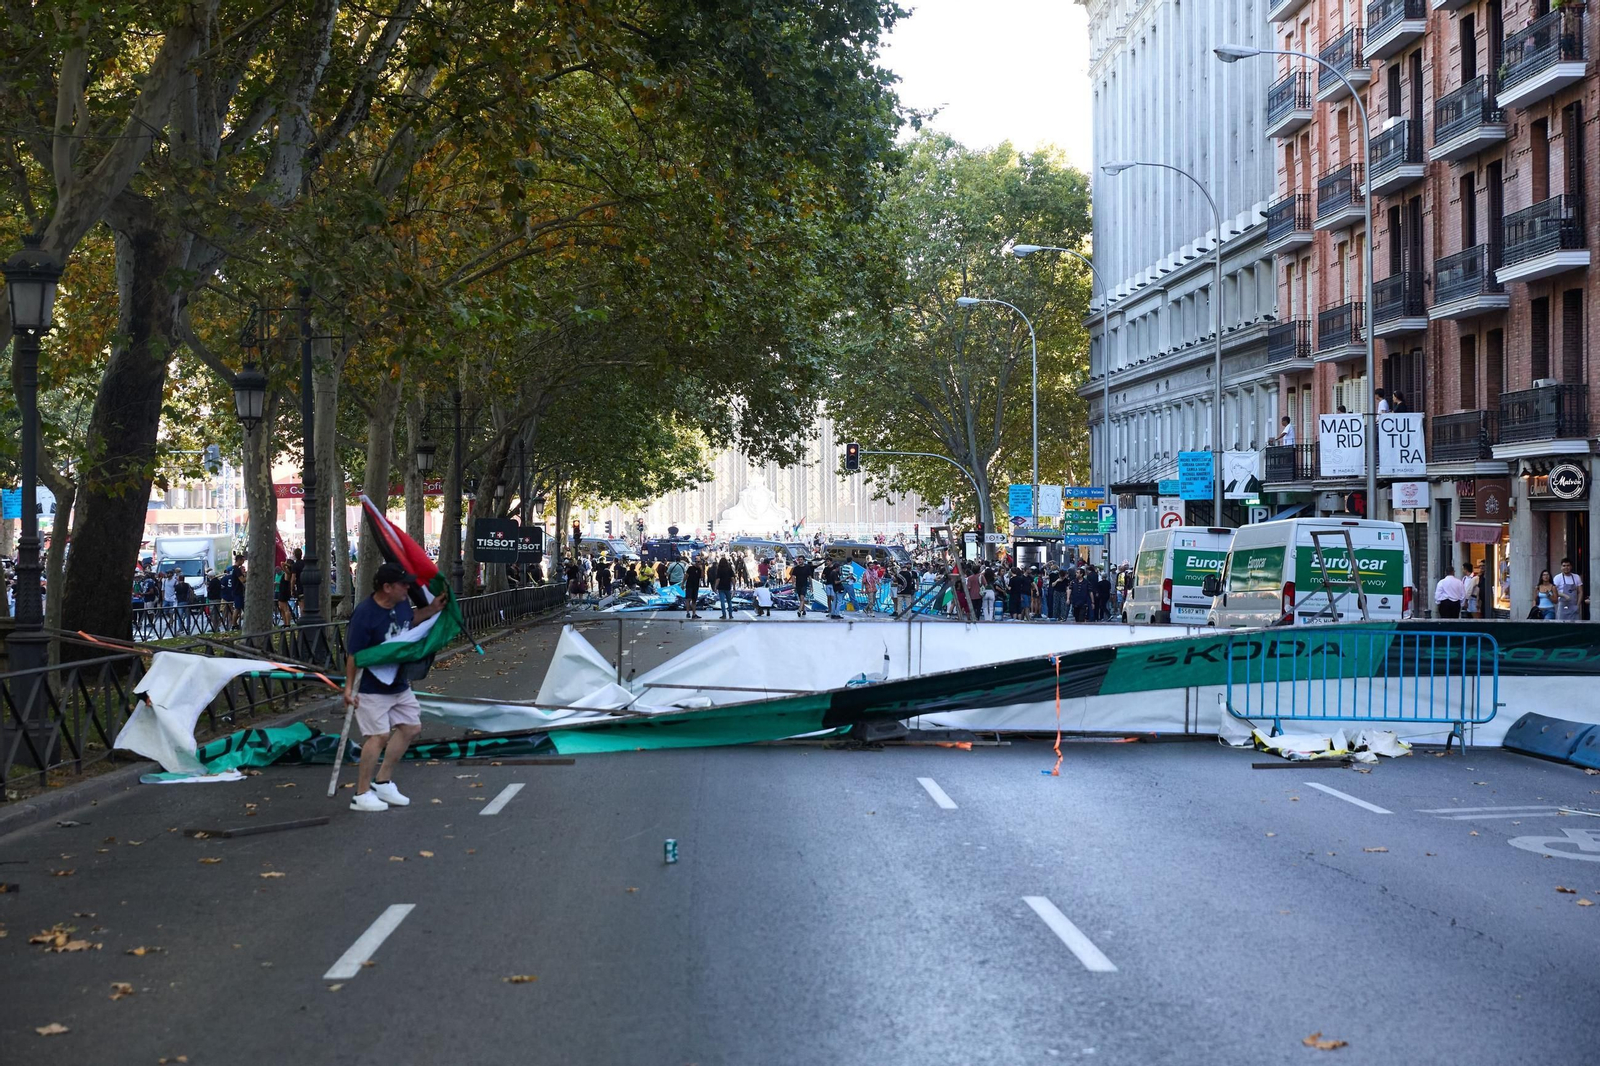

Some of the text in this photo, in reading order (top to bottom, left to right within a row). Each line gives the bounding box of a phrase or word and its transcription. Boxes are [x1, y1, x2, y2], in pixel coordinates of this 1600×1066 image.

[1321, 418, 1362, 434] MAD
[1381, 418, 1416, 433] CUL
[1336, 433, 1363, 449] RID
[1387, 433, 1410, 449] TU
[1400, 449, 1424, 464] RA
[1102, 507, 1113, 522] P
[1255, 508, 1267, 524] P
[476, 538, 516, 548] TISSOT
[1367, 579, 1387, 588] way
